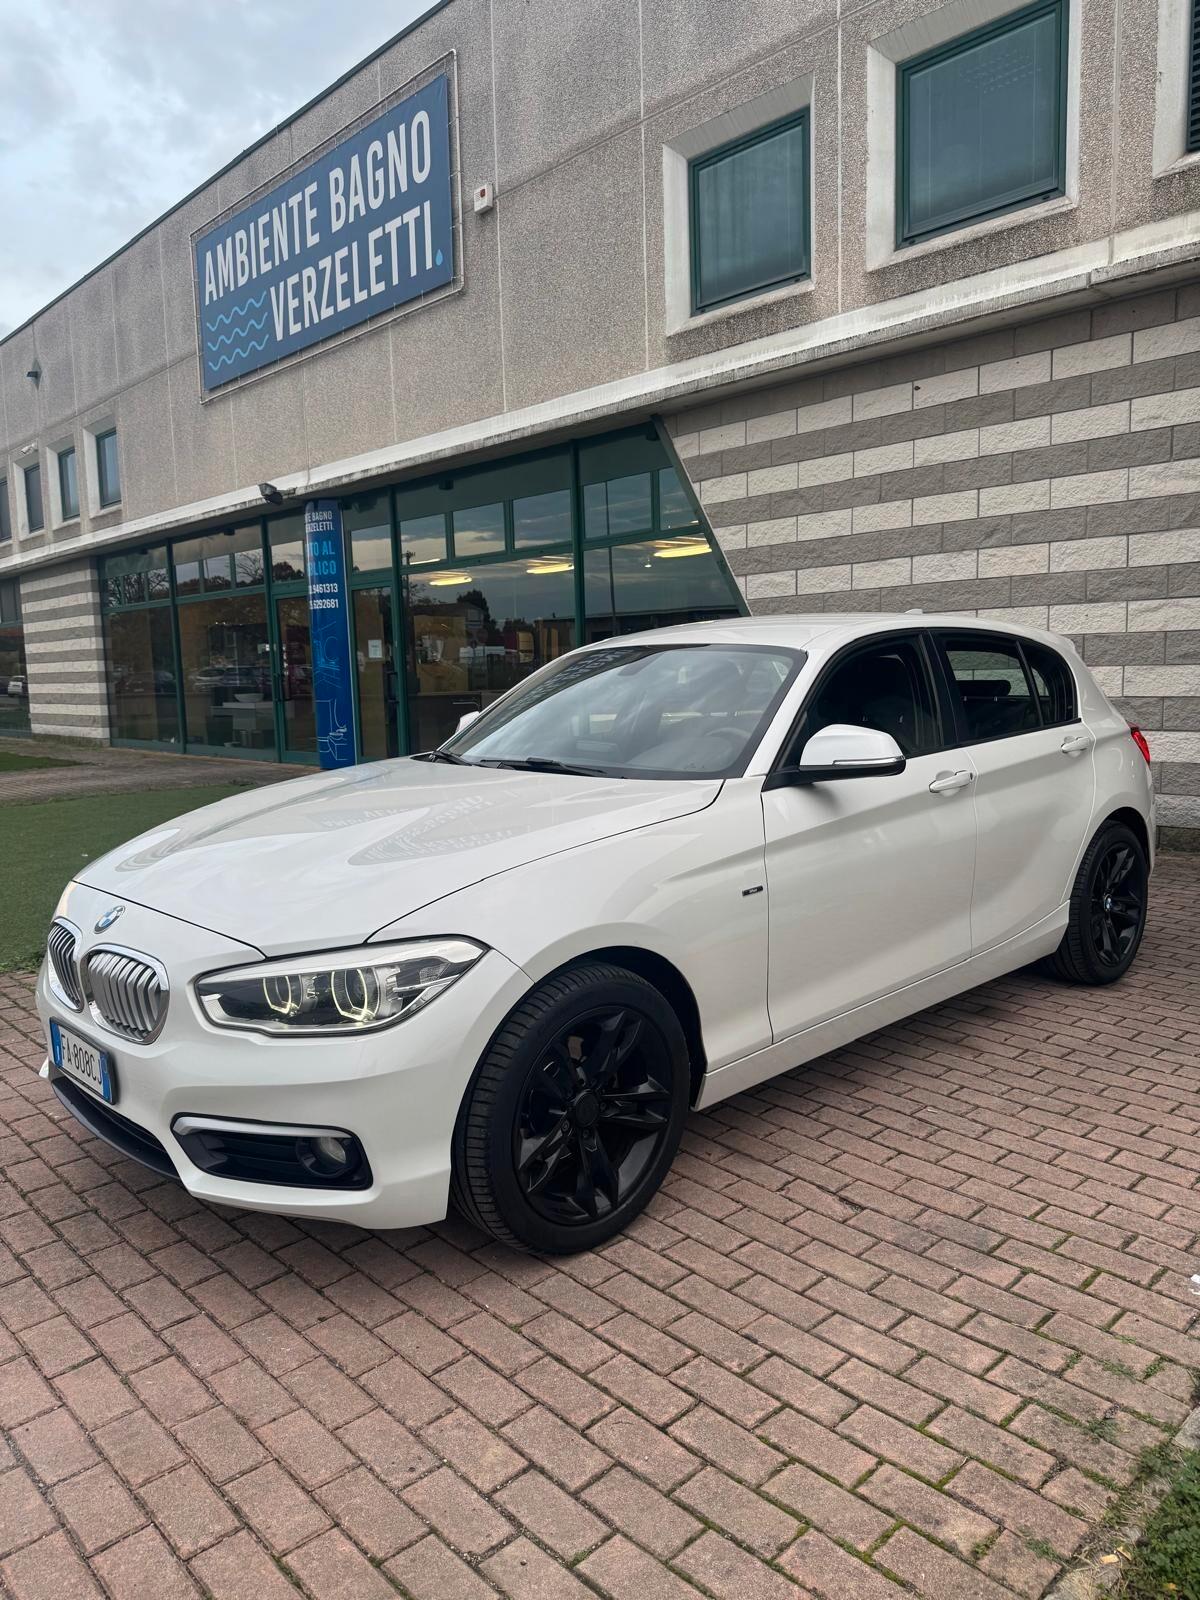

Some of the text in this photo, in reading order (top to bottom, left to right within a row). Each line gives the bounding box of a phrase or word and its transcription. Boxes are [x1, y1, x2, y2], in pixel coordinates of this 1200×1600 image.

[205, 110, 431, 305] AMBIENTE BAGNO
[270, 200, 433, 341] VERZELETTI
[312, 510, 333, 521] BAGNO
[322, 540, 336, 555] AL
